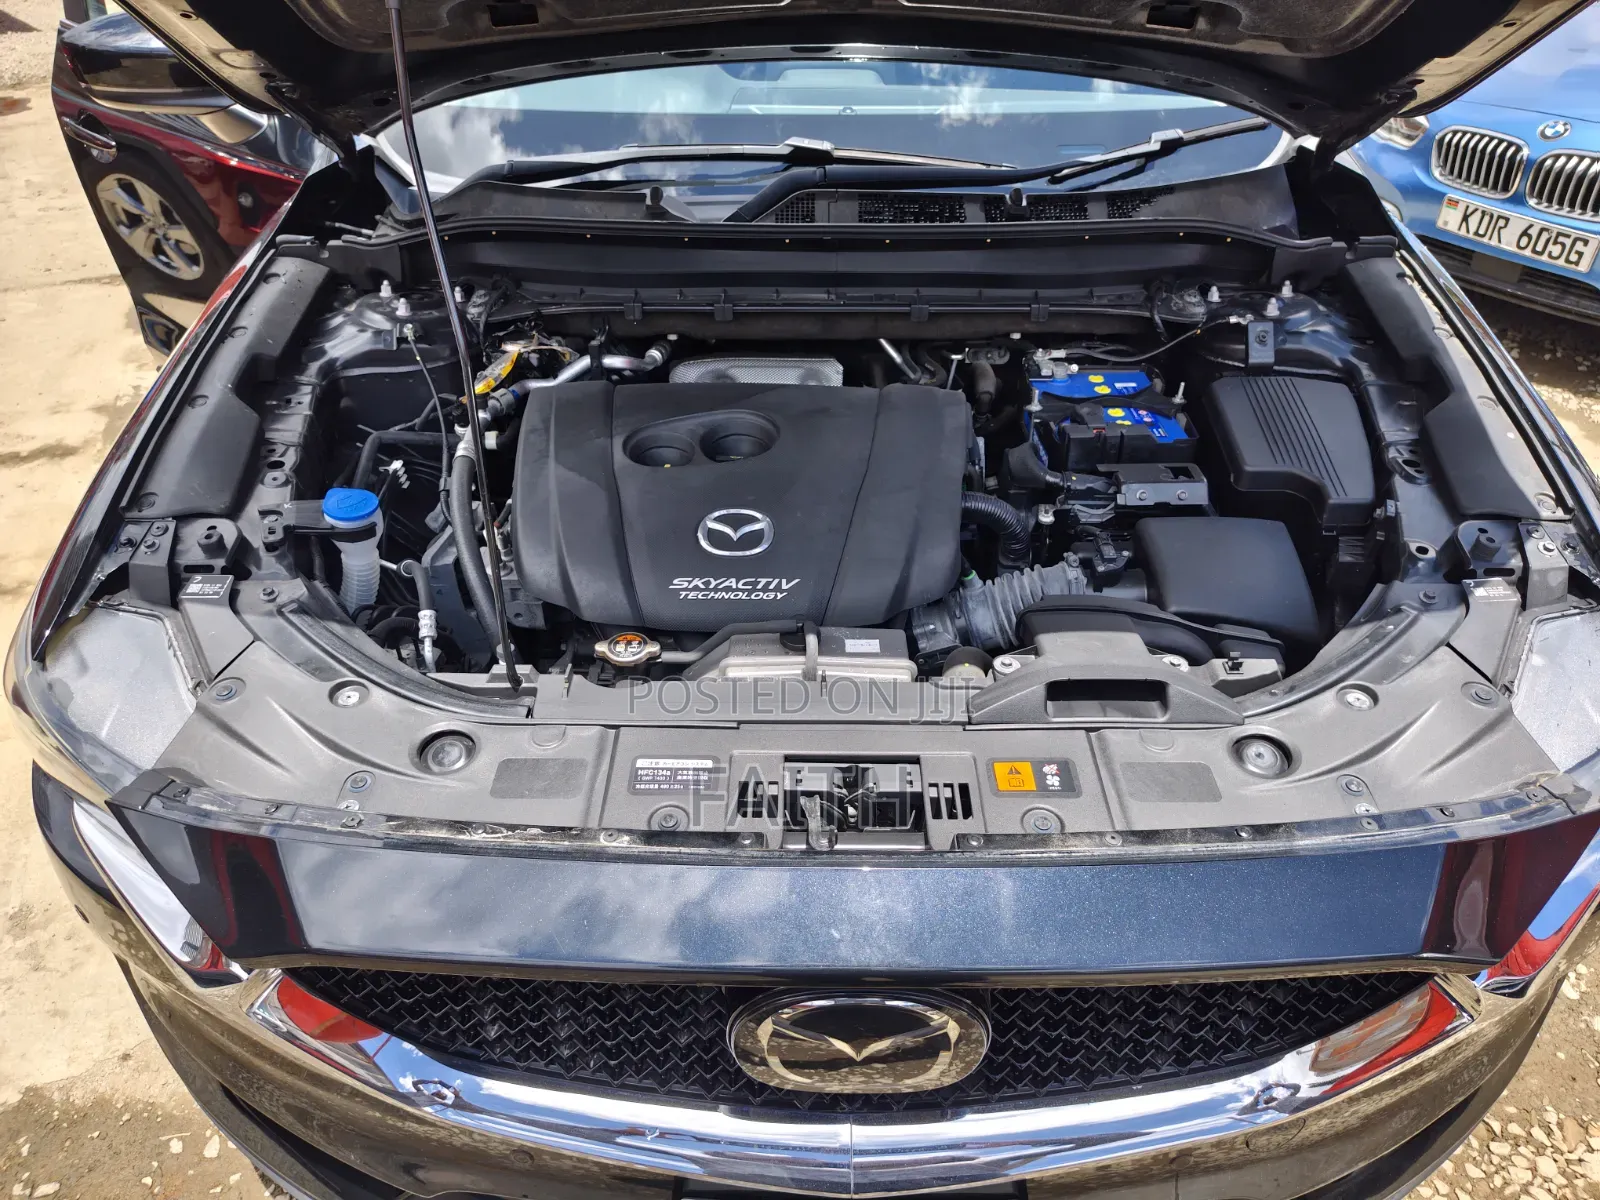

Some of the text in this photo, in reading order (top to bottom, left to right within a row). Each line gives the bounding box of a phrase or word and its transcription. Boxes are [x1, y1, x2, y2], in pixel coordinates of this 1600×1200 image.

[1457, 204, 1590, 267] KDR 605G
[668, 577, 801, 590] SKYACTIV
[679, 591, 788, 600] TECHNOLOGY
